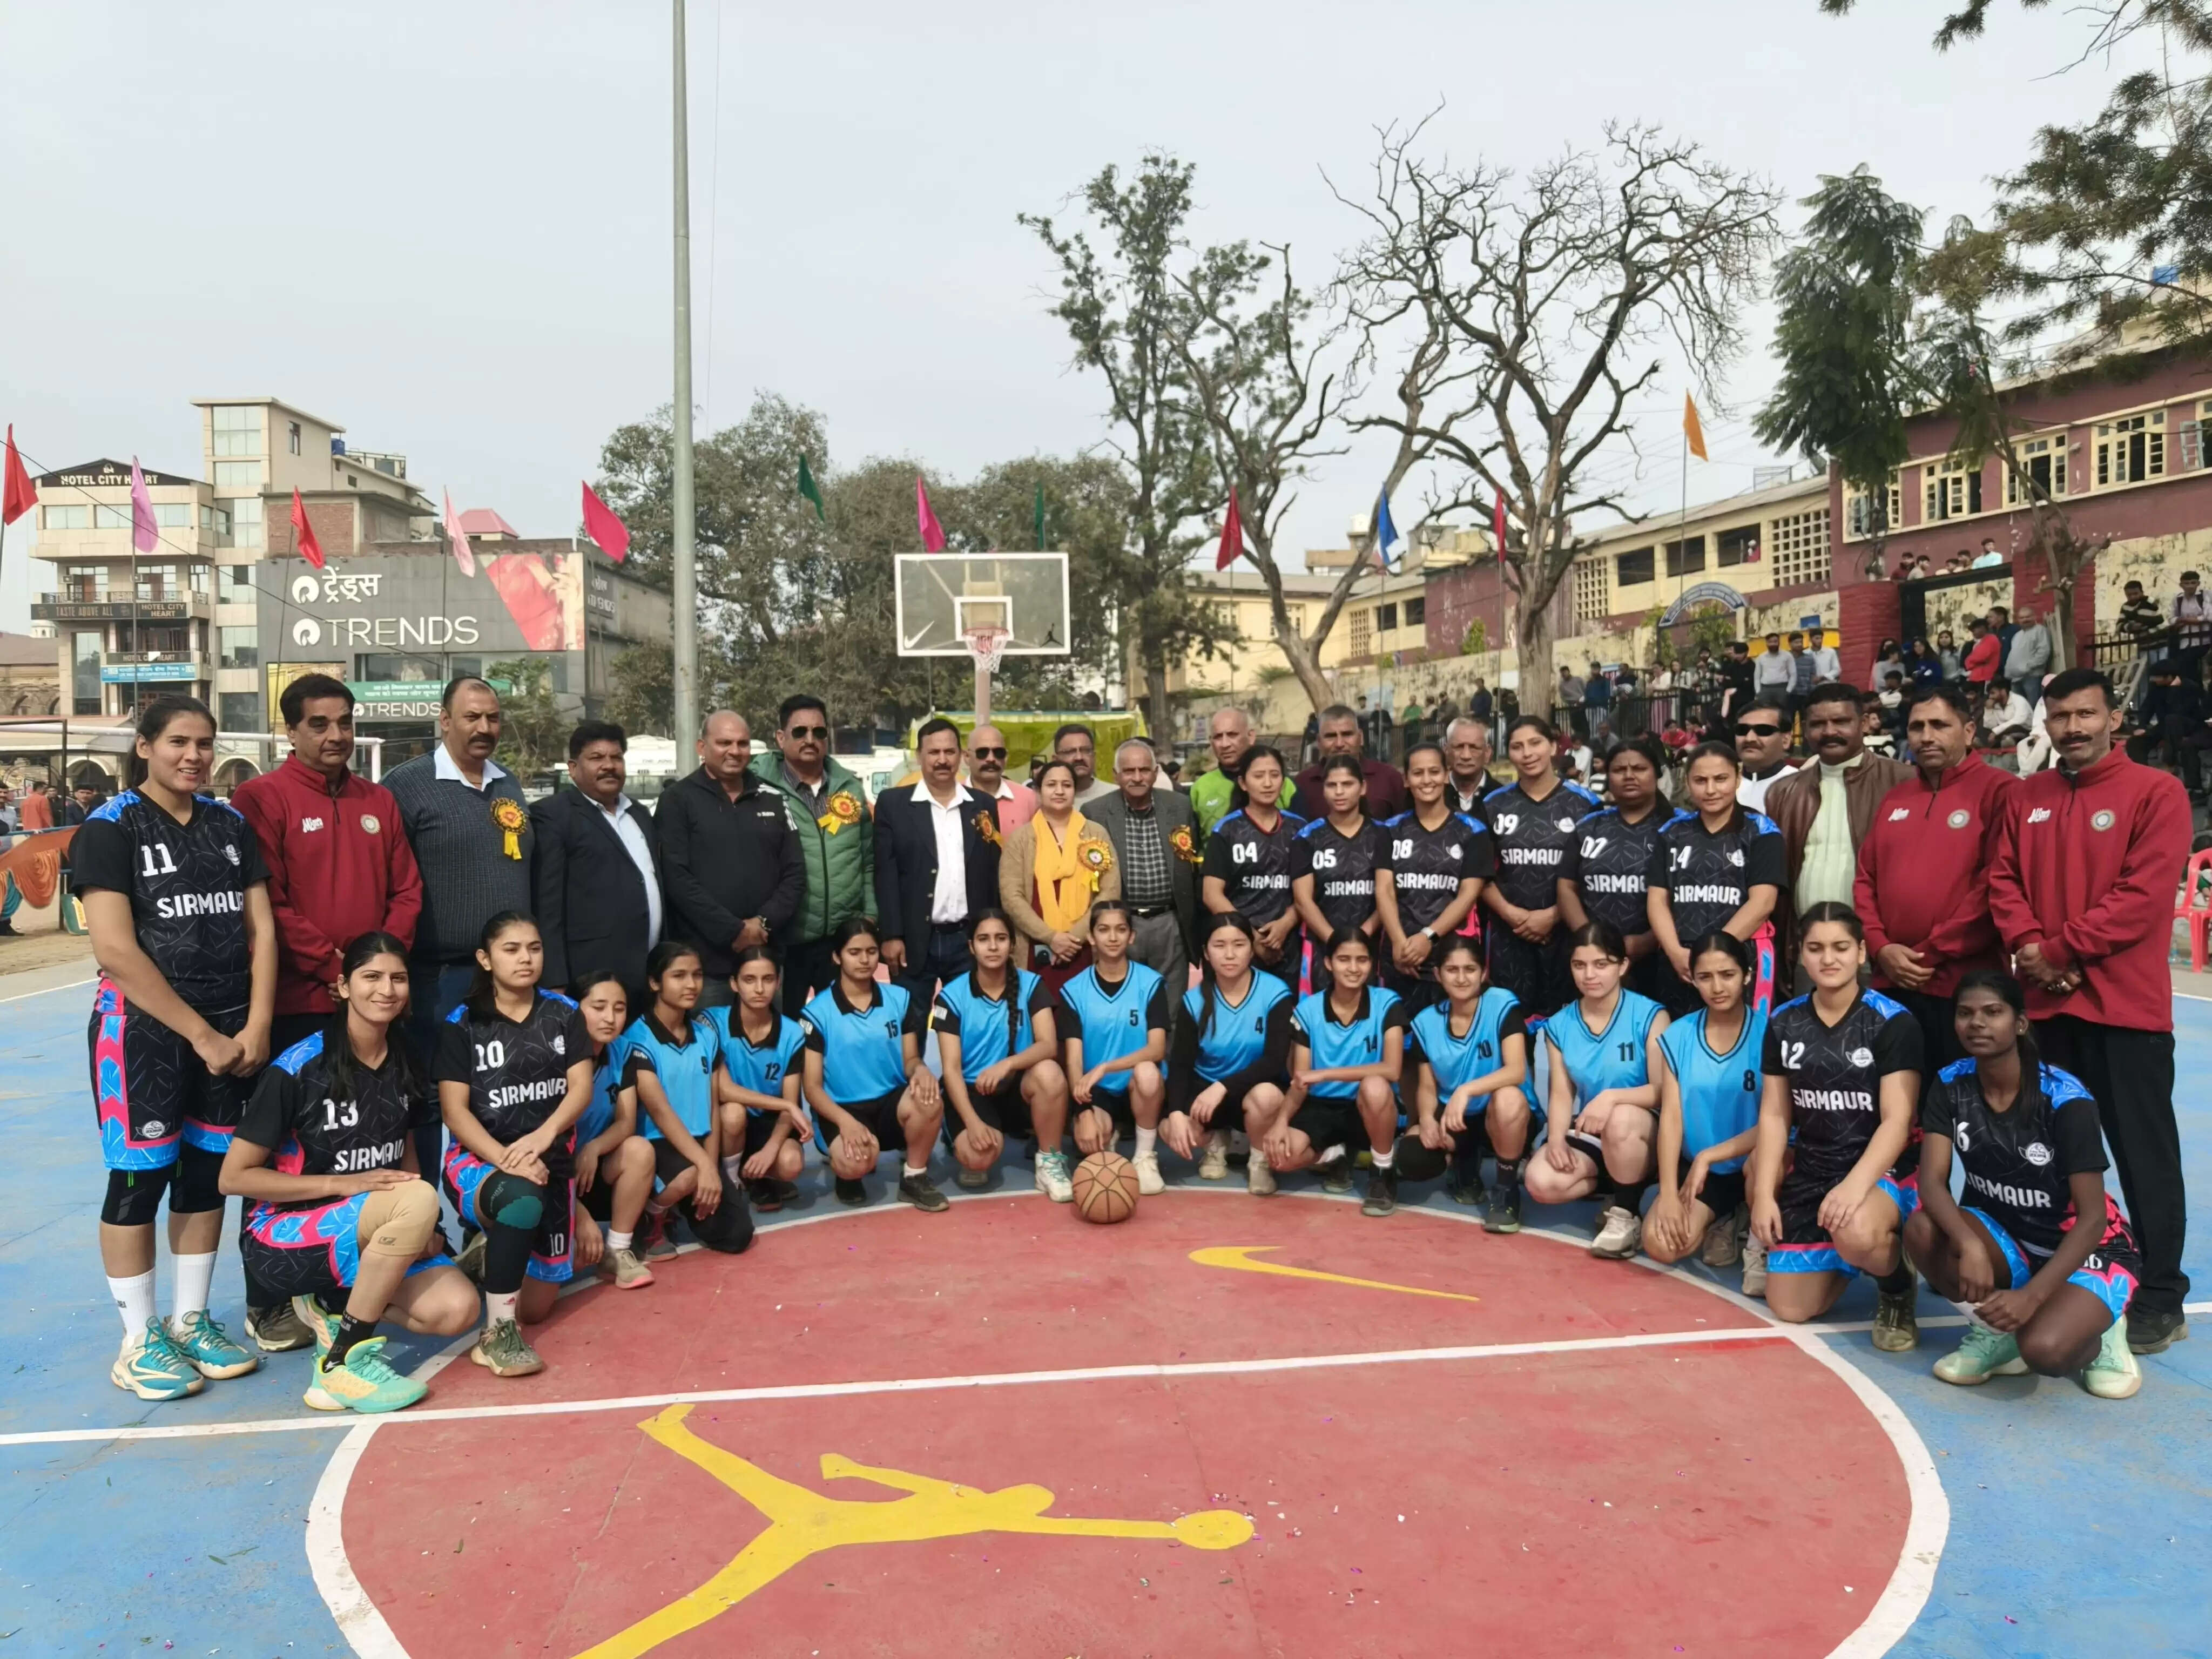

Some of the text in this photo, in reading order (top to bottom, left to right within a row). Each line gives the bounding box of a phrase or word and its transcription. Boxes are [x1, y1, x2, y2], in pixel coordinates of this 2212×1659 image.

[60, 475, 158, 485] HOTEL CITY HRT
[322, 565, 382, 603] ट्रेंड्स
[56, 606, 113, 616] TASTE ABOVE ALL
[325, 616, 478, 646] TRENDS
[366, 702, 442, 717] TRENDS
[1232, 842, 1258, 864] 04
[1392, 839, 1413, 860] 08
[1501, 848, 1563, 865] SIRMAU
[1580, 835, 1607, 859] 07
[141, 843, 177, 876] 11
[1312, 848, 1336, 869] 05
[1670, 846, 1692, 872] 14
[1242, 874, 1290, 889] SIRMAU
[1324, 880, 1374, 896] SIRMAU
[1396, 873, 1458, 891] SIRMAUR
[1584, 874, 1646, 893] SIRMA
[1130, 1009, 1138, 1027] 5
[1255, 1016, 1264, 1034] 4
[885, 1020, 899, 1038] 15
[1363, 1035, 1377, 1053] 14
[1617, 1041, 1634, 1062] 11
[1781, 1040, 1805, 1069] 12
[475, 1040, 504, 1071] 10
[701, 1056, 709, 1074] 9
[765, 1062, 780, 1081] 12
[1743, 1069, 1755, 1091] 8
[489, 1078, 567, 1108] SIRMAUR
[1792, 1089, 1873, 1111] SIRMAUR
[323, 1098, 359, 1131] 13
[1952, 1118, 1970, 1152] 6
[334, 1139, 404, 1171] SIRMAU
[1967, 1171, 2052, 1208] IRMAUR
[550, 1233, 564, 1257] 10
